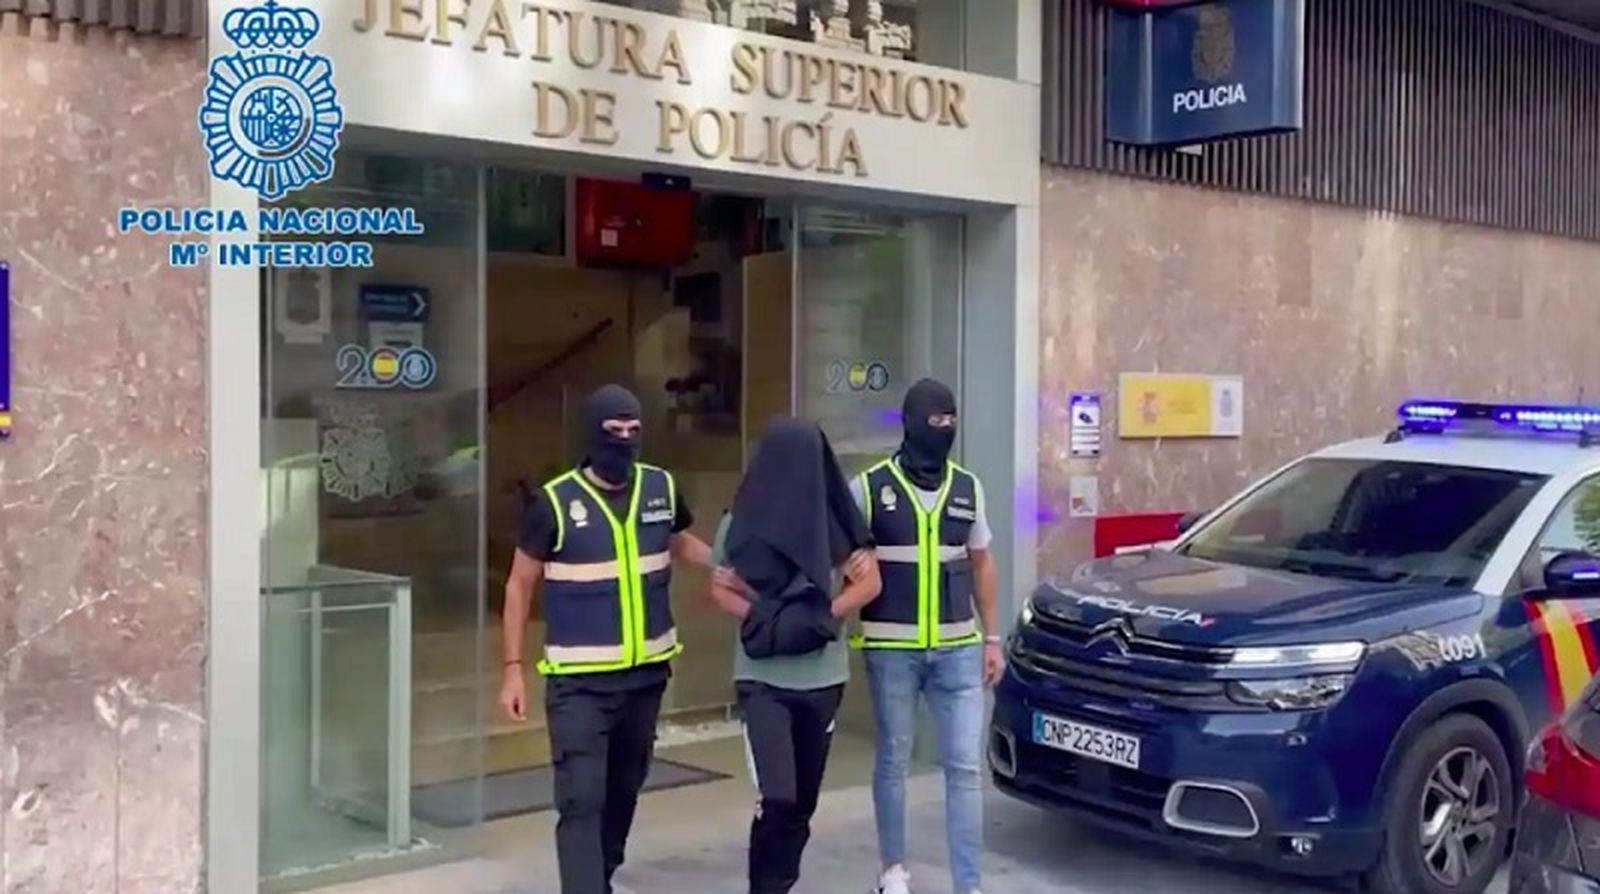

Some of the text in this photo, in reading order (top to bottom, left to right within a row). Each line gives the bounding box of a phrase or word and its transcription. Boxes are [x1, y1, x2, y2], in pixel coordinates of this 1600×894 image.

[352, 0, 967, 128] JEFATURA SUPERIOR
[1173, 83, 1247, 114] POLICIA
[532, 81, 868, 176] DE POLICÍA
